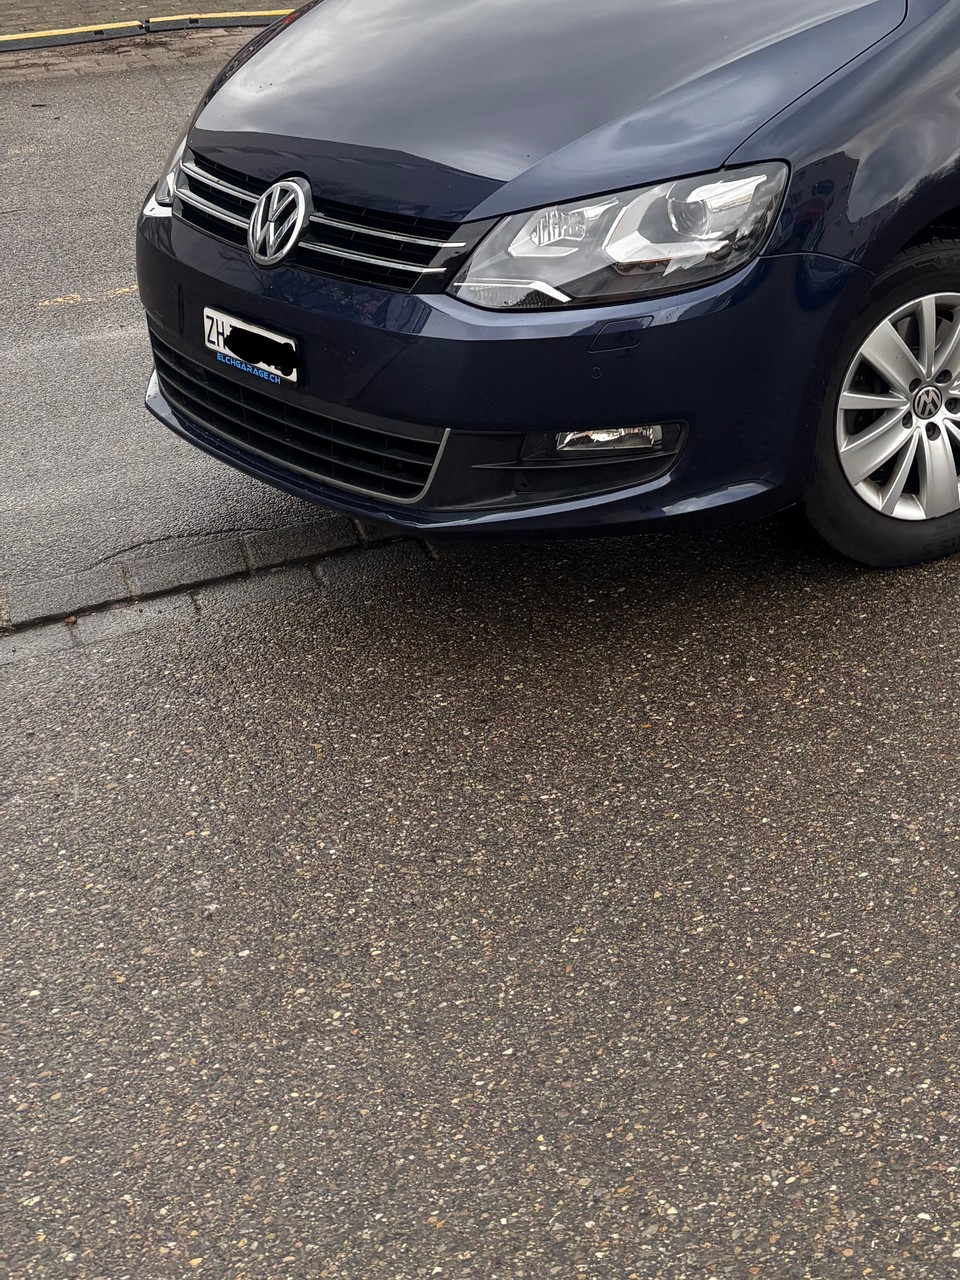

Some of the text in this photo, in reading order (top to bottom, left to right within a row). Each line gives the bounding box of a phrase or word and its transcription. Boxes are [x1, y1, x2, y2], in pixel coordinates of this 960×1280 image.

[249, 182, 304, 263] VW
[205, 314, 226, 350] ZH
[216, 352, 281, 385] ELCHGARAGE.CH
